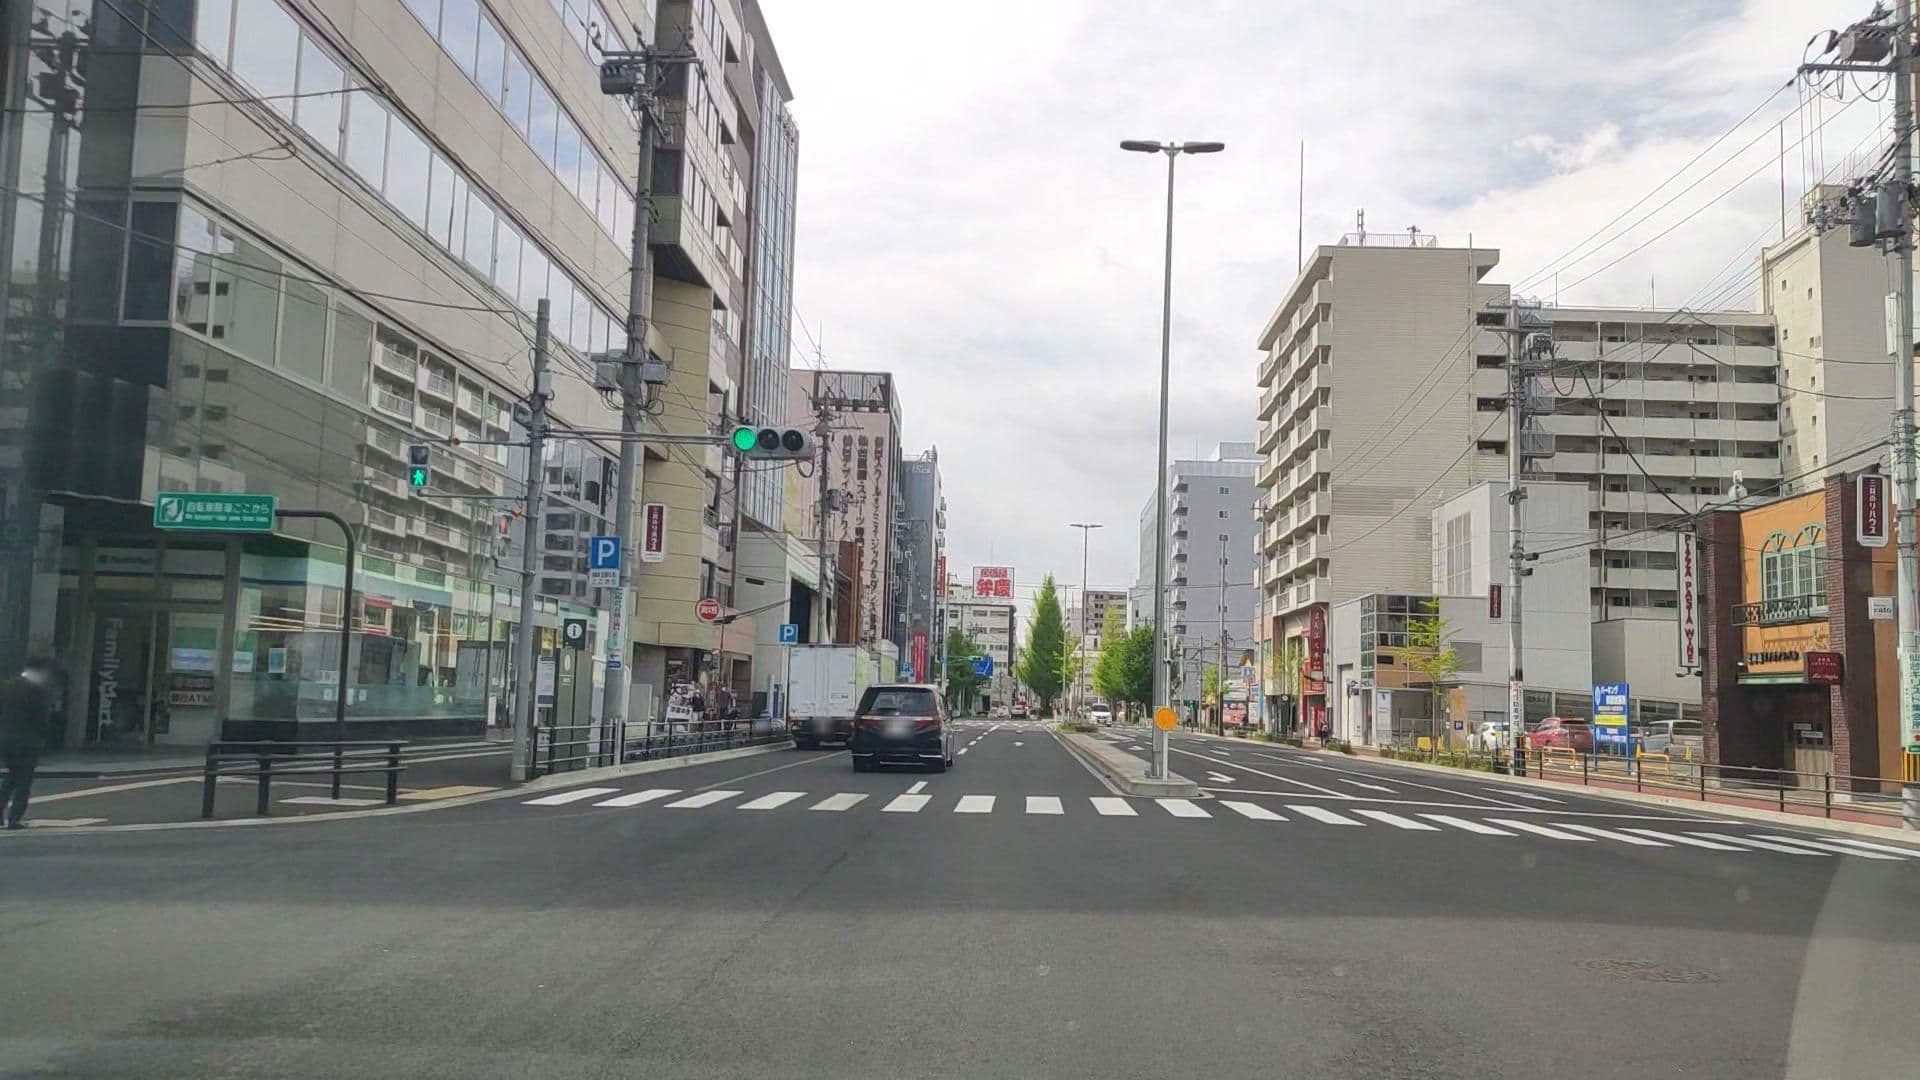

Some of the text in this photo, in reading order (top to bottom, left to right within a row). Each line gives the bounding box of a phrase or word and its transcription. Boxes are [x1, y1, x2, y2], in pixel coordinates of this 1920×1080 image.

[1868, 480, 1877, 534] 三井のリハウス
[597, 539, 615, 567] P
[1684, 534, 1695, 663] PIZZA PASTA WINE
[784, 626, 795, 641] P
[98, 618, 123, 727] FamilyMart
